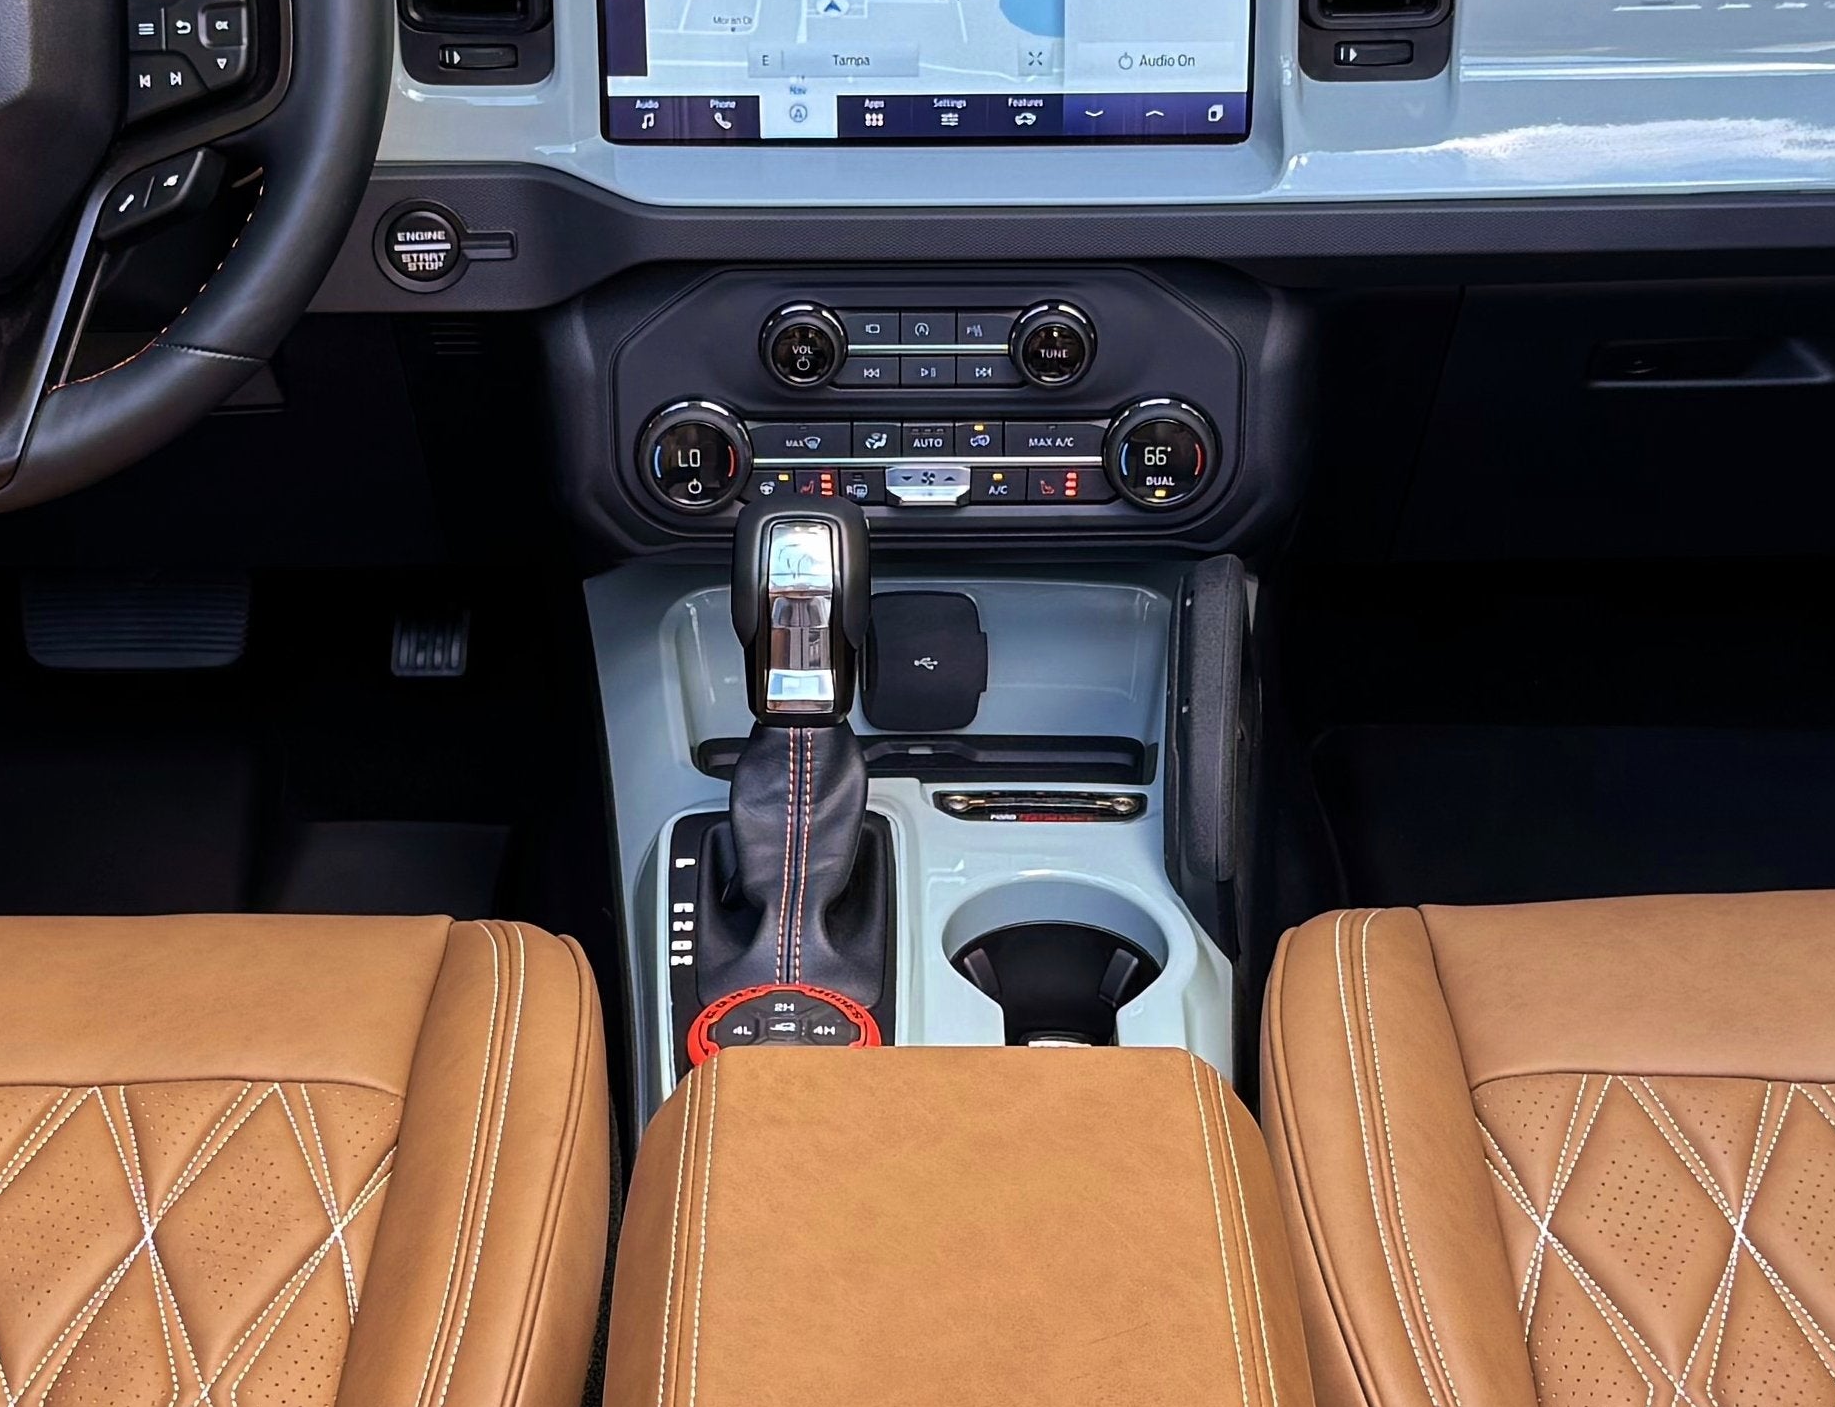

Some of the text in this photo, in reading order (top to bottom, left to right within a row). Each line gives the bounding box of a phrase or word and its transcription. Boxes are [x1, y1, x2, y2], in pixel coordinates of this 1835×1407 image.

[762, 55, 769, 66] E
[833, 54, 870, 67] Tampa
[1139, 53, 1196, 67] Audio On
[635, 99, 659, 109] Audio
[709, 99, 736, 109] Phone
[864, 98, 885, 109] Apps
[933, 98, 967, 109] Settings
[1008, 97, 1044, 108] Features
[397, 230, 446, 242] ENGINE
[401, 252, 447, 263] START
[407, 261, 444, 272] STOP
[792, 345, 814, 355] VOL
[1040, 348, 1069, 359] TUNE
[913, 438, 943, 448] AUTO
[1028, 437, 1075, 448] MAX A/C
[677, 449, 701, 468] LO
[1146, 476, 1176, 487] DUAL
[988, 485, 1008, 495] A/C
[732, 1025, 752, 1036] 4L
[813, 1025, 836, 1036] 4H
